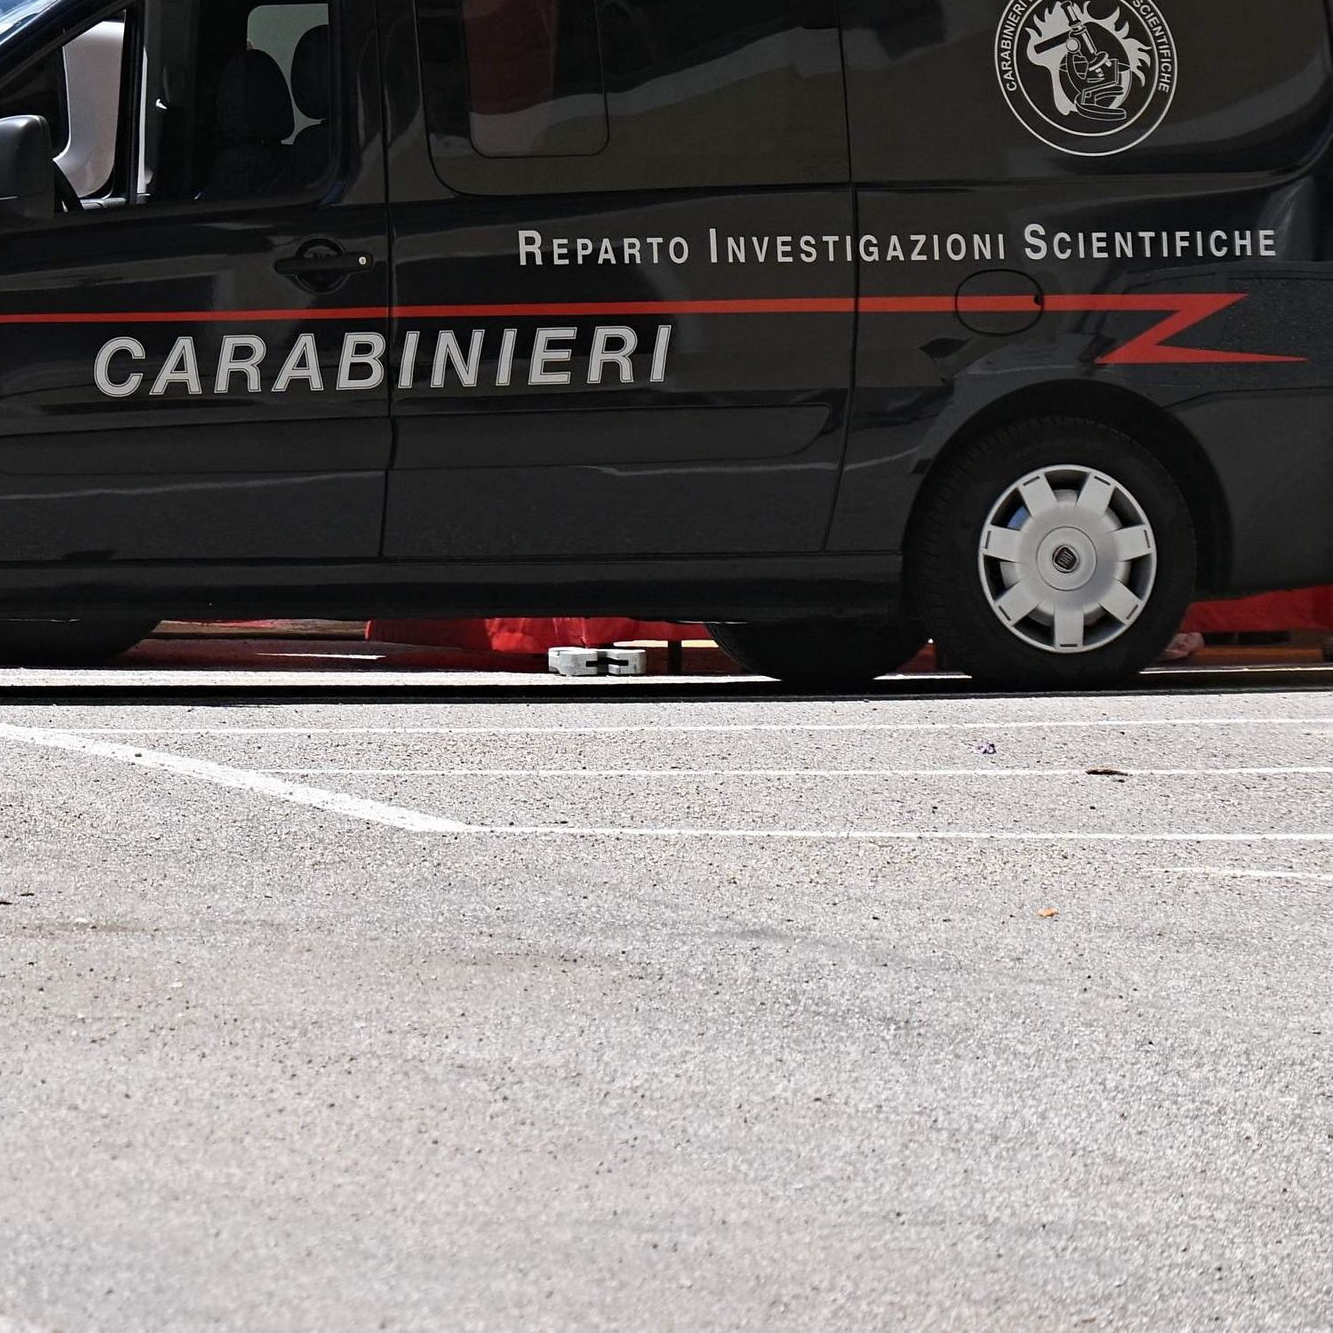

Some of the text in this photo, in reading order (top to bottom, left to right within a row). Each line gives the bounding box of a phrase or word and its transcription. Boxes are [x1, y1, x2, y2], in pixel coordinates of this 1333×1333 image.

[1001, 0, 1027, 91] CARABINIERI
[518, 223, 1276, 265] REPARTO INVESTIGAZIONI SCIENTIFICHE
[92, 324, 672, 398] CARABINIERI
